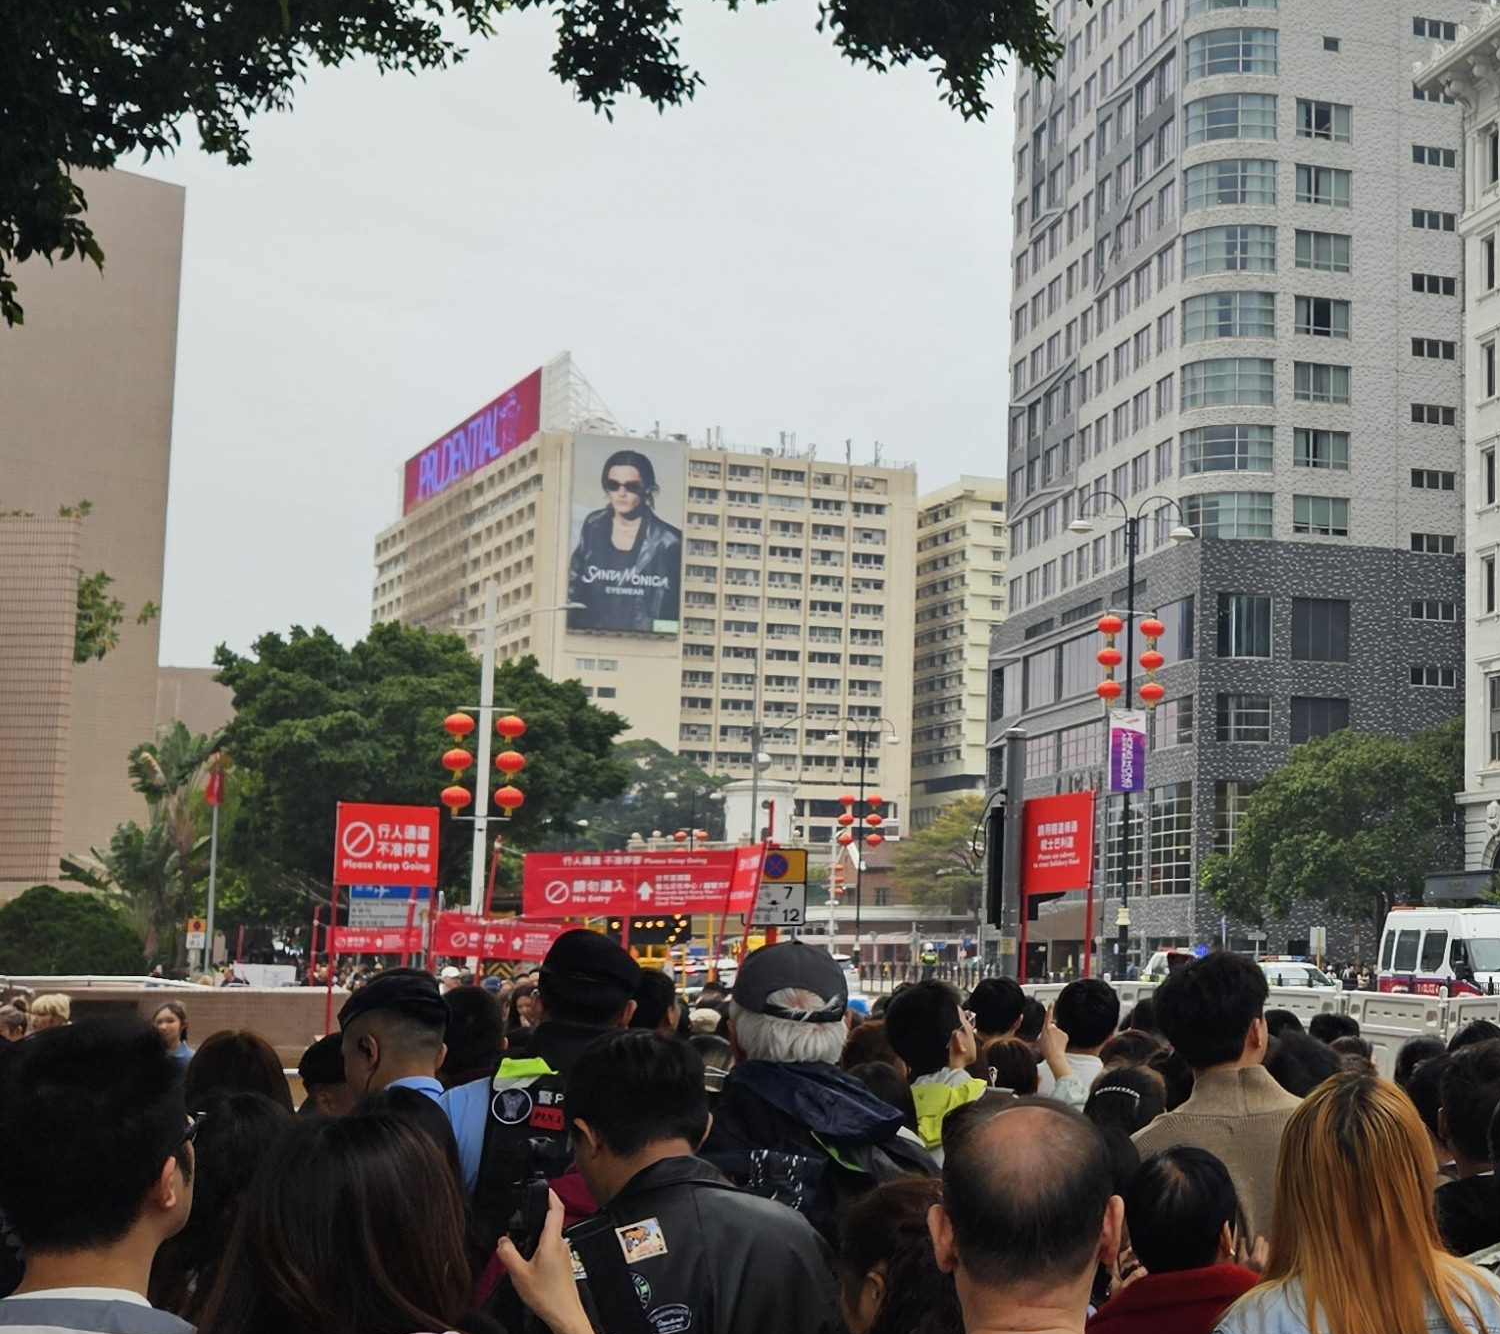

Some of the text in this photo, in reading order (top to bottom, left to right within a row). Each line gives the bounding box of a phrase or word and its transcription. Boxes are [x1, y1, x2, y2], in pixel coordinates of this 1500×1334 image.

[417, 405, 501, 501] PRUDENTIAL
[582, 566, 670, 589] SANTA MONICA
[605, 586, 645, 596] EYEWEAR
[343, 859, 430, 874] Please Keep Going
[783, 886, 793, 900] 7
[783, 908, 800, 922] 12
